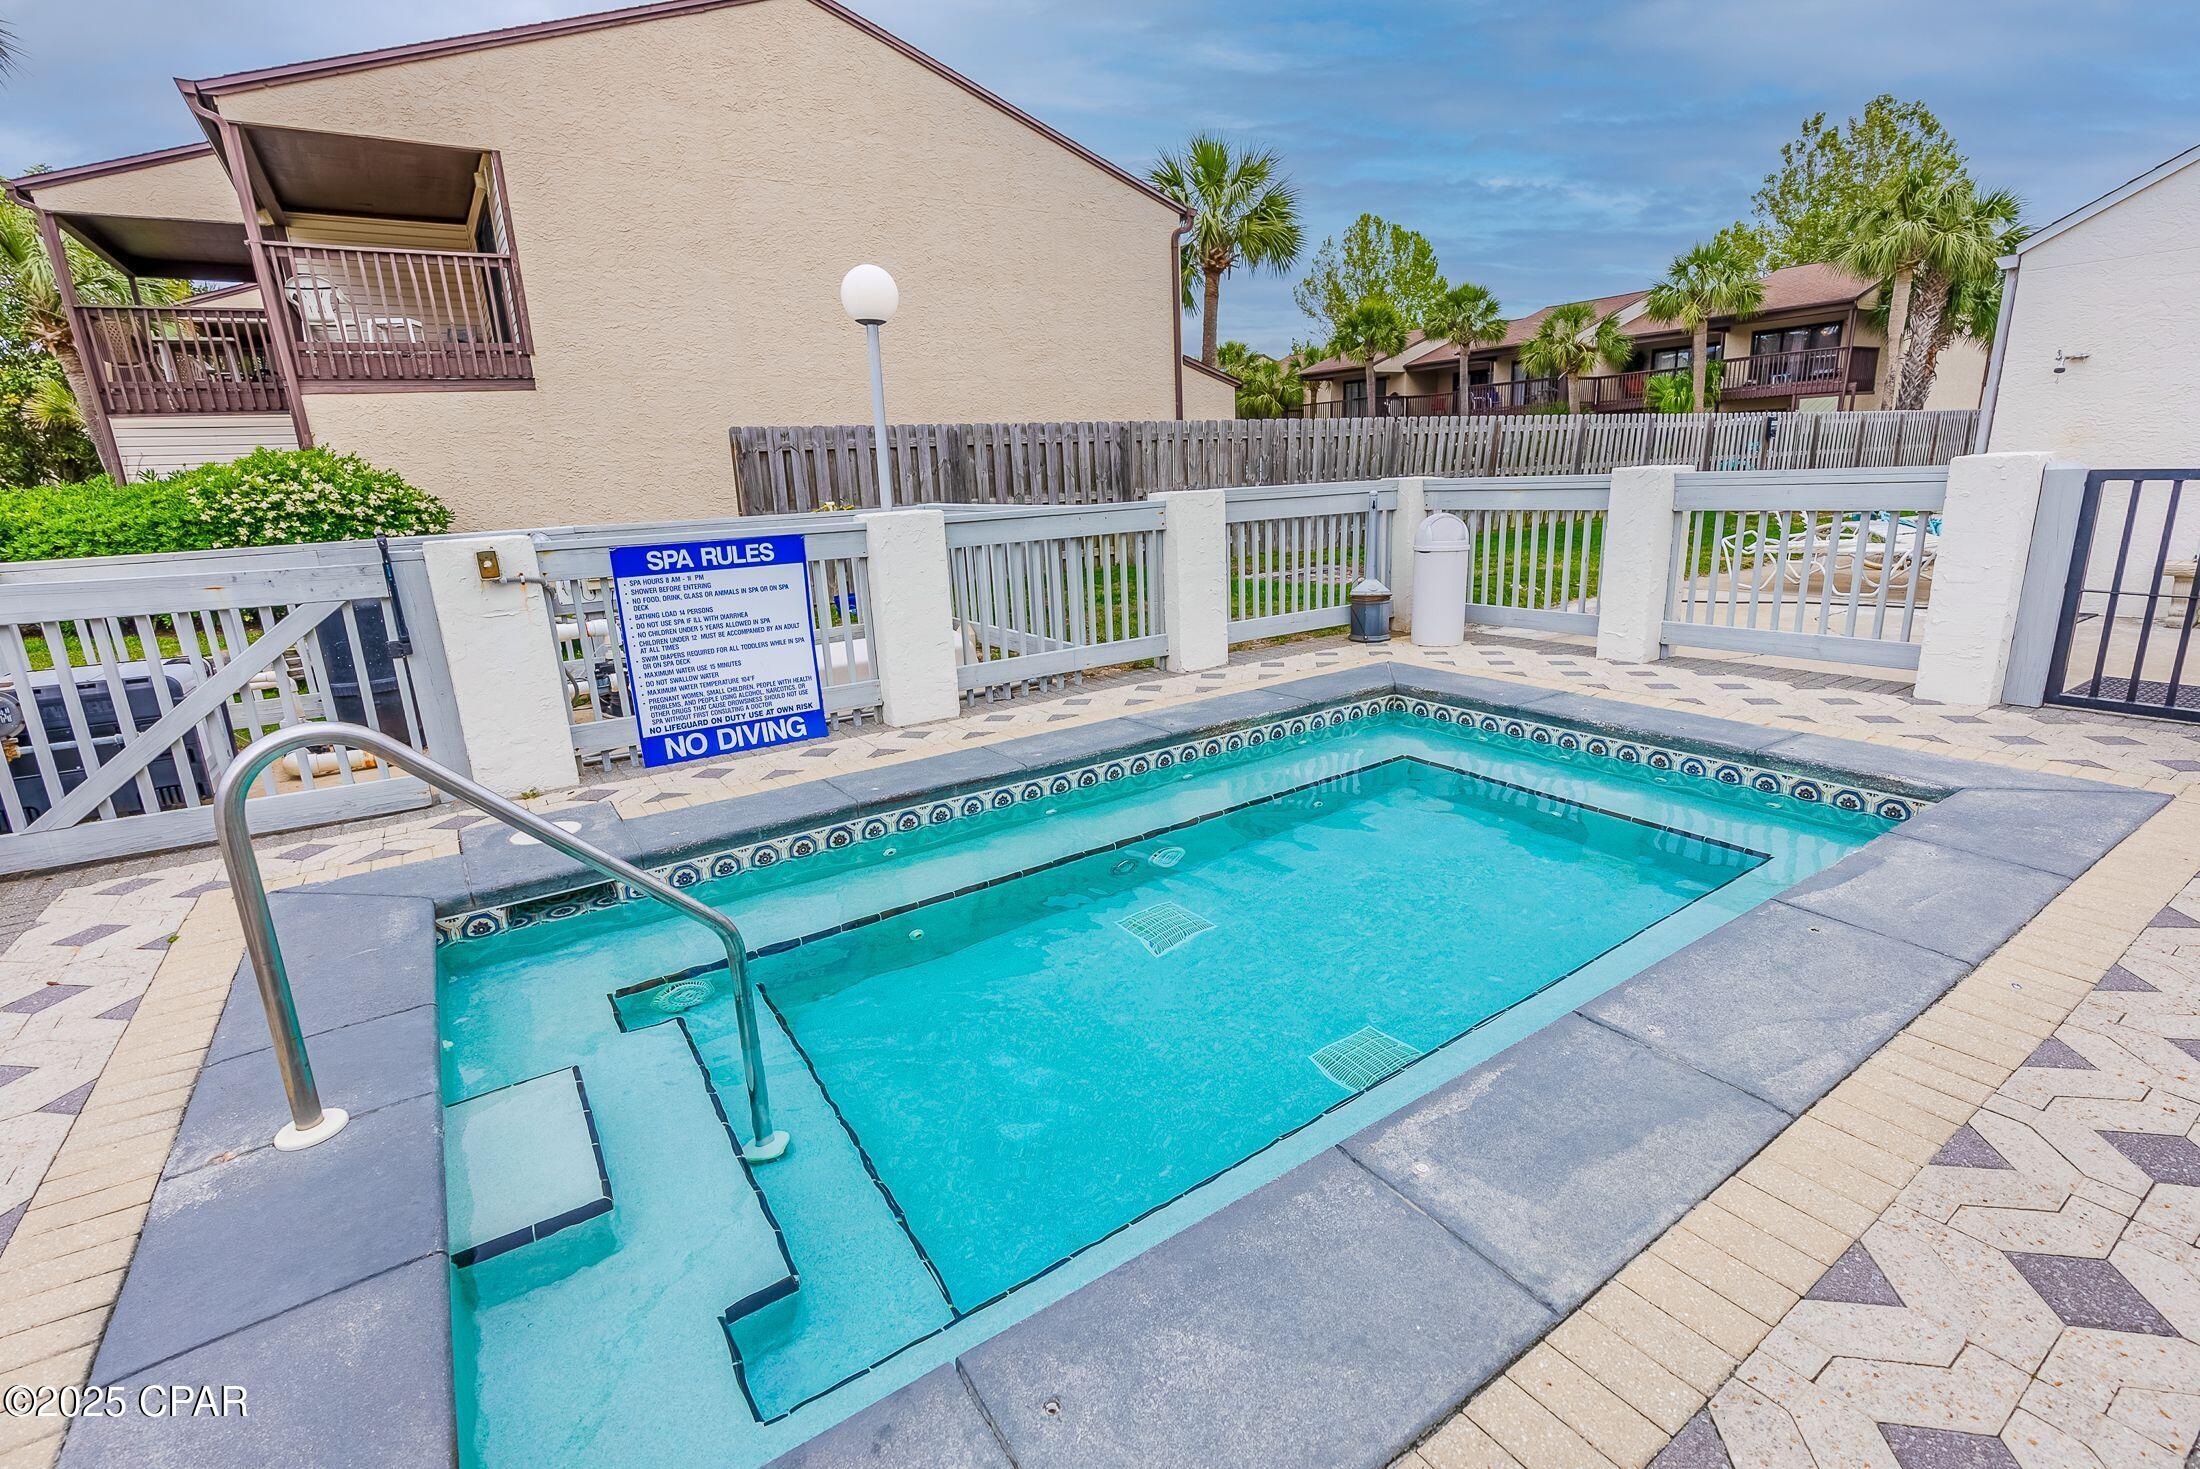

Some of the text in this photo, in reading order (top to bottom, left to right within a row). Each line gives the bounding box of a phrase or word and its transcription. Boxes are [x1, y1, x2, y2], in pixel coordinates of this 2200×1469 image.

[646, 542, 775, 571] SPA RULES
[630, 582, 712, 596] SHOWER BEFORE ENTERING
[714, 589, 740, 597] ANIMALS
[634, 612, 660, 620] BATHING
[687, 607, 713, 615] PERSONS
[720, 612, 749, 620] DIARRHEA
[639, 638, 668, 647] CHILDREN
[669, 635, 690, 643] UNDER
[700, 632, 717, 640] MUST
[726, 627, 765, 637] ACCOMPANIED
[648, 628, 677, 637] CHILDREN
[704, 623, 724, 631] YEARS
[725, 620, 752, 628] ALLOWED
[641, 655, 659, 663] SWIM
[660, 652, 686, 660] DIAPERS
[686, 648, 715, 657] REQUIRED
[740, 642, 769, 650] TODDLERS
[661, 644, 680, 652] TIMES
[644, 669, 675, 678] MAXIMUM
[676, 666, 696, 674] WATER
[717, 660, 742, 669] MINUTES
[676, 658, 691, 666] DECK
[647, 686, 677, 696] MAXIMUM
[678, 683, 698, 691] WATER
[699, 678, 739, 689] TEMPERATURE
[669, 675, 699, 684] SWALLOW
[700, 672, 720, 680] WATER
[648, 695, 680, 704] PREGNANT
[706, 688, 725, 696] SMALL
[756, 681, 776, 689] PEOPLE
[792, 676, 813, 684] HEALTH
[698, 696, 719, 704] PEOPLE
[720, 693, 737, 701] USING
[650, 710, 670, 718] OTHER
[671, 707, 692, 715] DRUGS
[708, 702, 727, 710] CAUSE
[728, 696, 763, 707] DROWSINESS
[764, 693, 786, 701] SHOULD
[664, 714, 692, 723] WITHOUT
[693, 711, 709, 719] FIRST
[710, 706, 744, 716] CONSULTING
[751, 701, 773, 710] DOCTOR
[649, 702, 814, 735] NO LIFEGUARD ON DUTY USE AT OWN RISK
[664, 716, 808, 760] NO DIVING
